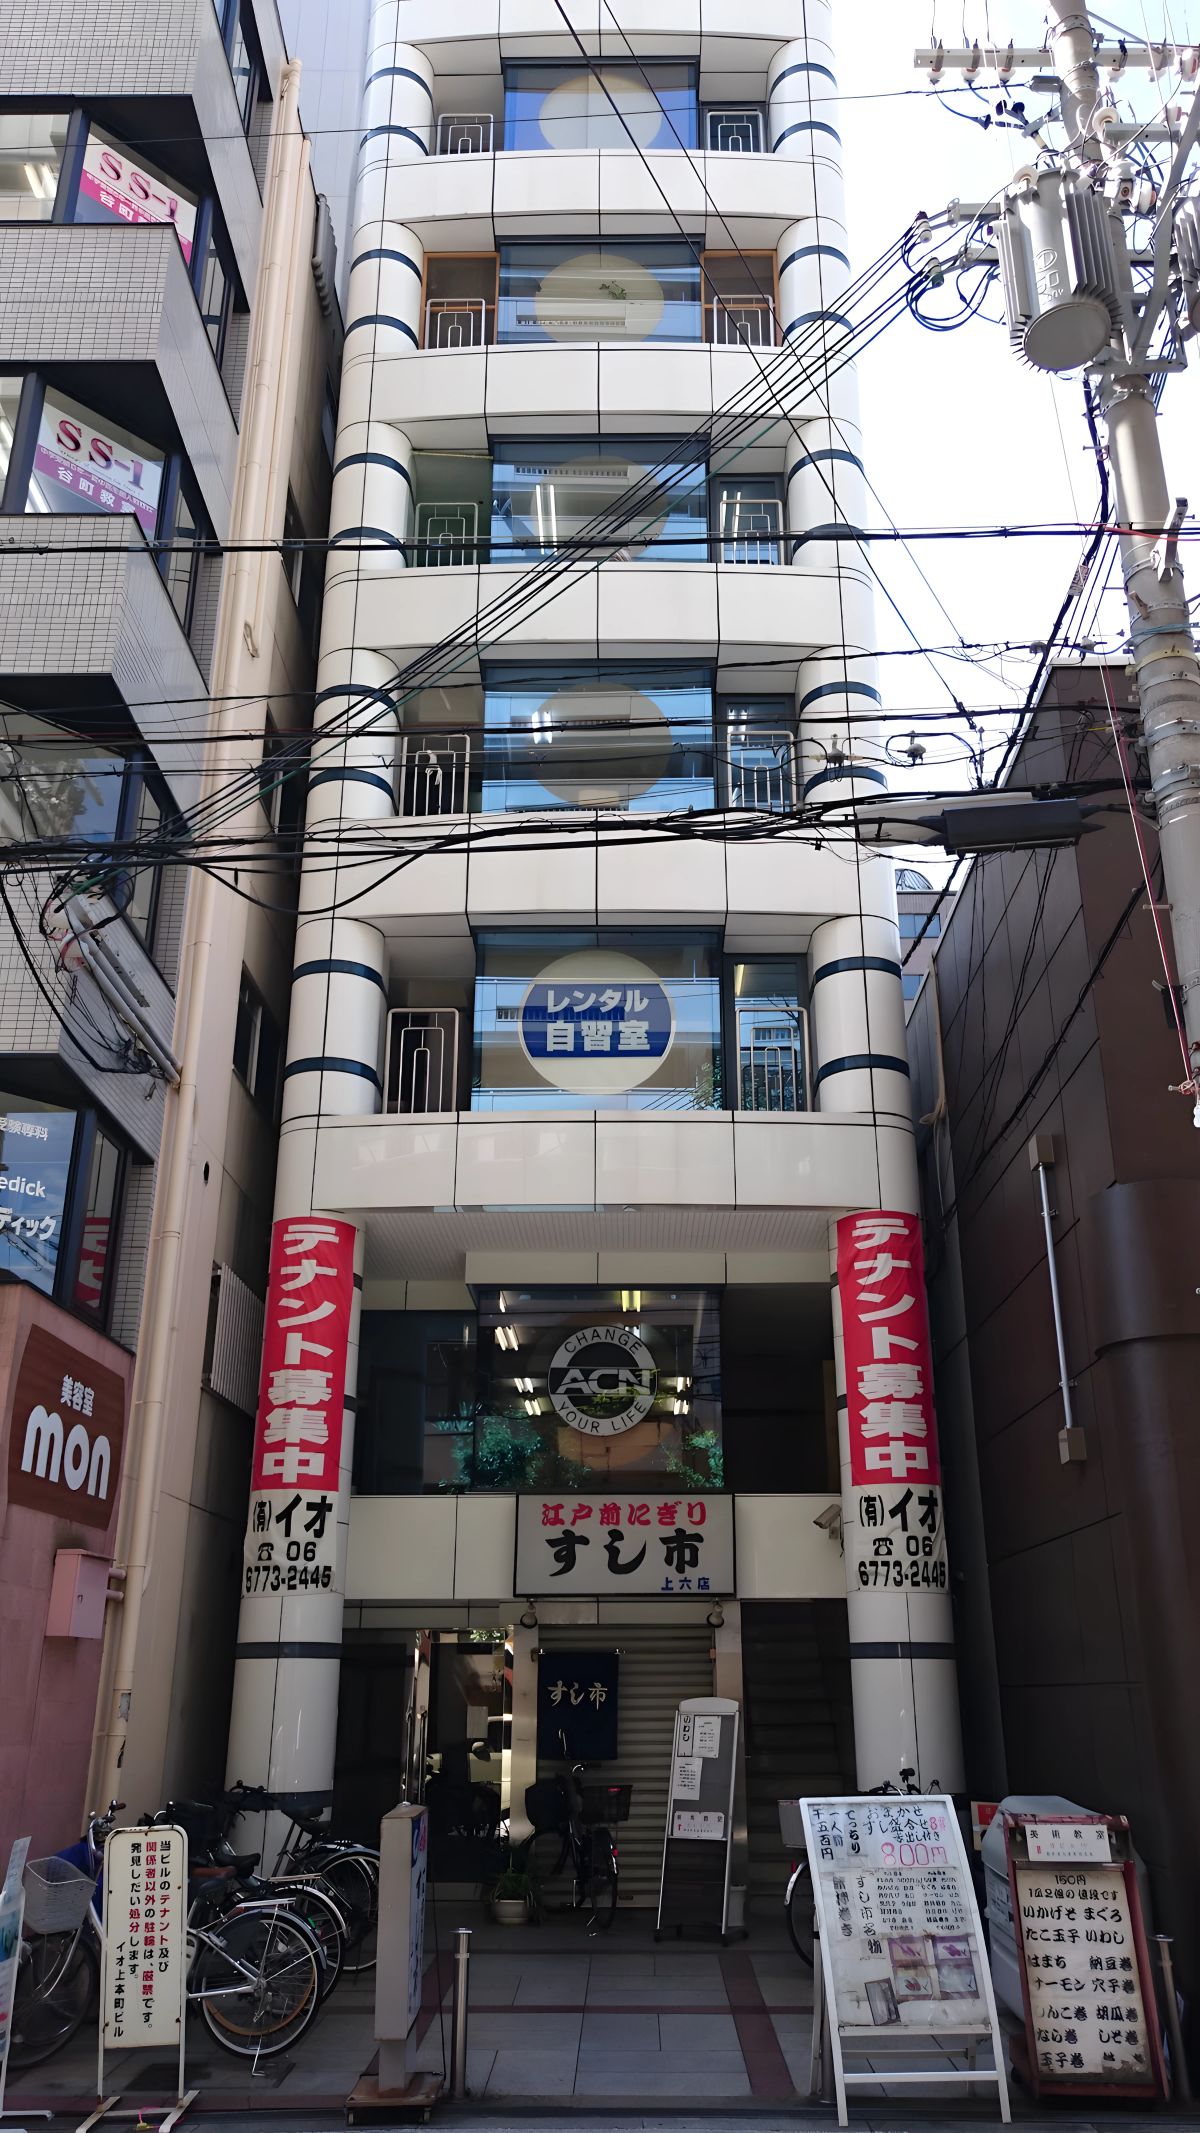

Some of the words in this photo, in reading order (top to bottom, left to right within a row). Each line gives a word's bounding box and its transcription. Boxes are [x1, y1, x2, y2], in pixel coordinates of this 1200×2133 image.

[99, 152, 178, 223] SS-1
[57, 420, 144, 490] SS-1
[547, 989, 649, 1013] レンタル
[547, 1020, 650, 1051] 自習室
[261, 1224, 340, 1483] テナント募集中
[565, 1328, 643, 1355] CHANGE
[852, 1218, 929, 1478] テナント募集中
[60, 1374, 95, 1417] 美容室
[555, 1369, 651, 1395] ACN
[558, 1401, 600, 1433] YOUR
[611, 1402, 647, 1431] LIFE
[20, 1404, 111, 1500] mon
[541, 1501, 707, 1527] 江戸前にぎり
[286, 1541, 317, 1562] 06
[545, 1528, 704, 1577] すし市
[906, 1535, 933, 1557] 06
[245, 1565, 333, 1593] 6773-2445
[661, 1577, 710, 1591] 上六店
[858, 1560, 946, 1588] 6773-2445
[547, 1680, 608, 1711] すし市
[866, 1805, 924, 1819] おまかせ
[881, 1842, 948, 1866] 800円
[1055, 1875, 1087, 1885] 150円
[128, 1842, 142, 1978] 発見しだい処分します。
[158, 1841, 172, 1973] 当ビルのテナント及び
[1023, 1906, 1077, 1920] いかげそ
[1083, 1907, 1122, 1922] まぐろ
[142, 1841, 157, 2028] 関係者以外の駐輪は、厳禁です。
[1085, 1929, 1124, 1944] いわし
[1028, 1954, 1067, 1969] はまち
[1089, 1955, 1133, 1971] 納豆巻
[114, 1942, 126, 2037] イオ上本町ビル
[1092, 1978, 1135, 1994] 穴子巻
[1096, 2005, 1138, 2022] 胡瓜巻
[1098, 2029, 1139, 2045] しそ巻
